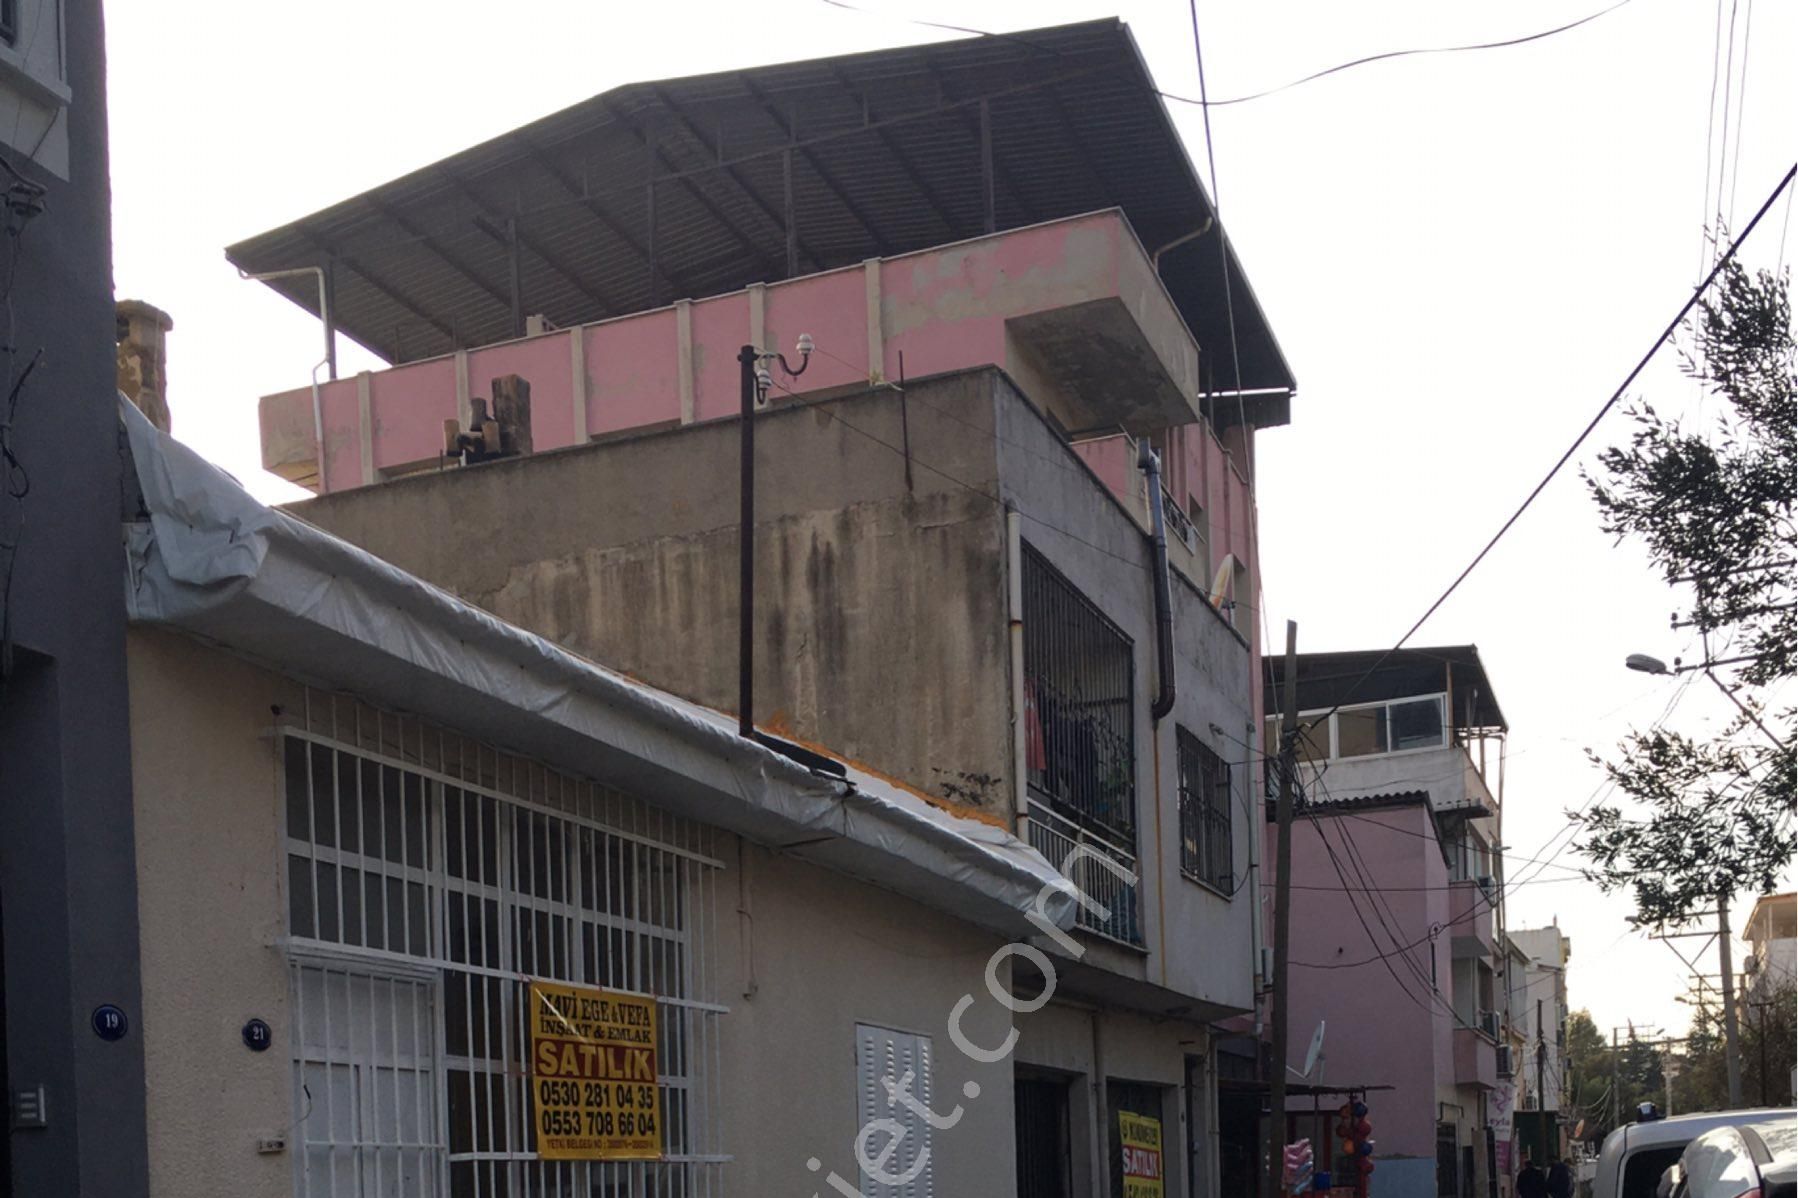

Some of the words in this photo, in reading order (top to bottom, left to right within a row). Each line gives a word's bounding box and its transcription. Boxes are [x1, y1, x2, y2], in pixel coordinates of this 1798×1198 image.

[105, 1013, 118, 1029] 19
[540, 992, 578, 1019] MAVİ
[581, 998, 609, 1022] EGE
[618, 1003, 651, 1027] VEFA
[252, 1025, 264, 1040] 21
[593, 1025, 605, 1039] &
[607, 1026, 651, 1043] EMLAK
[538, 1041, 654, 1080] SATILIK
[541, 1080, 580, 1106] 0530
[585, 1084, 610, 1108] 281
[616, 1086, 633, 1109] 04
[638, 1087, 654, 1109] 35
[542, 1110, 581, 1136] 0553
[586, 1112, 614, 1136] 708
[618, 1113, 634, 1136] 66
[638, 1113, 655, 1136] 04
[1123, 1147, 1157, 1177] SATILIK
